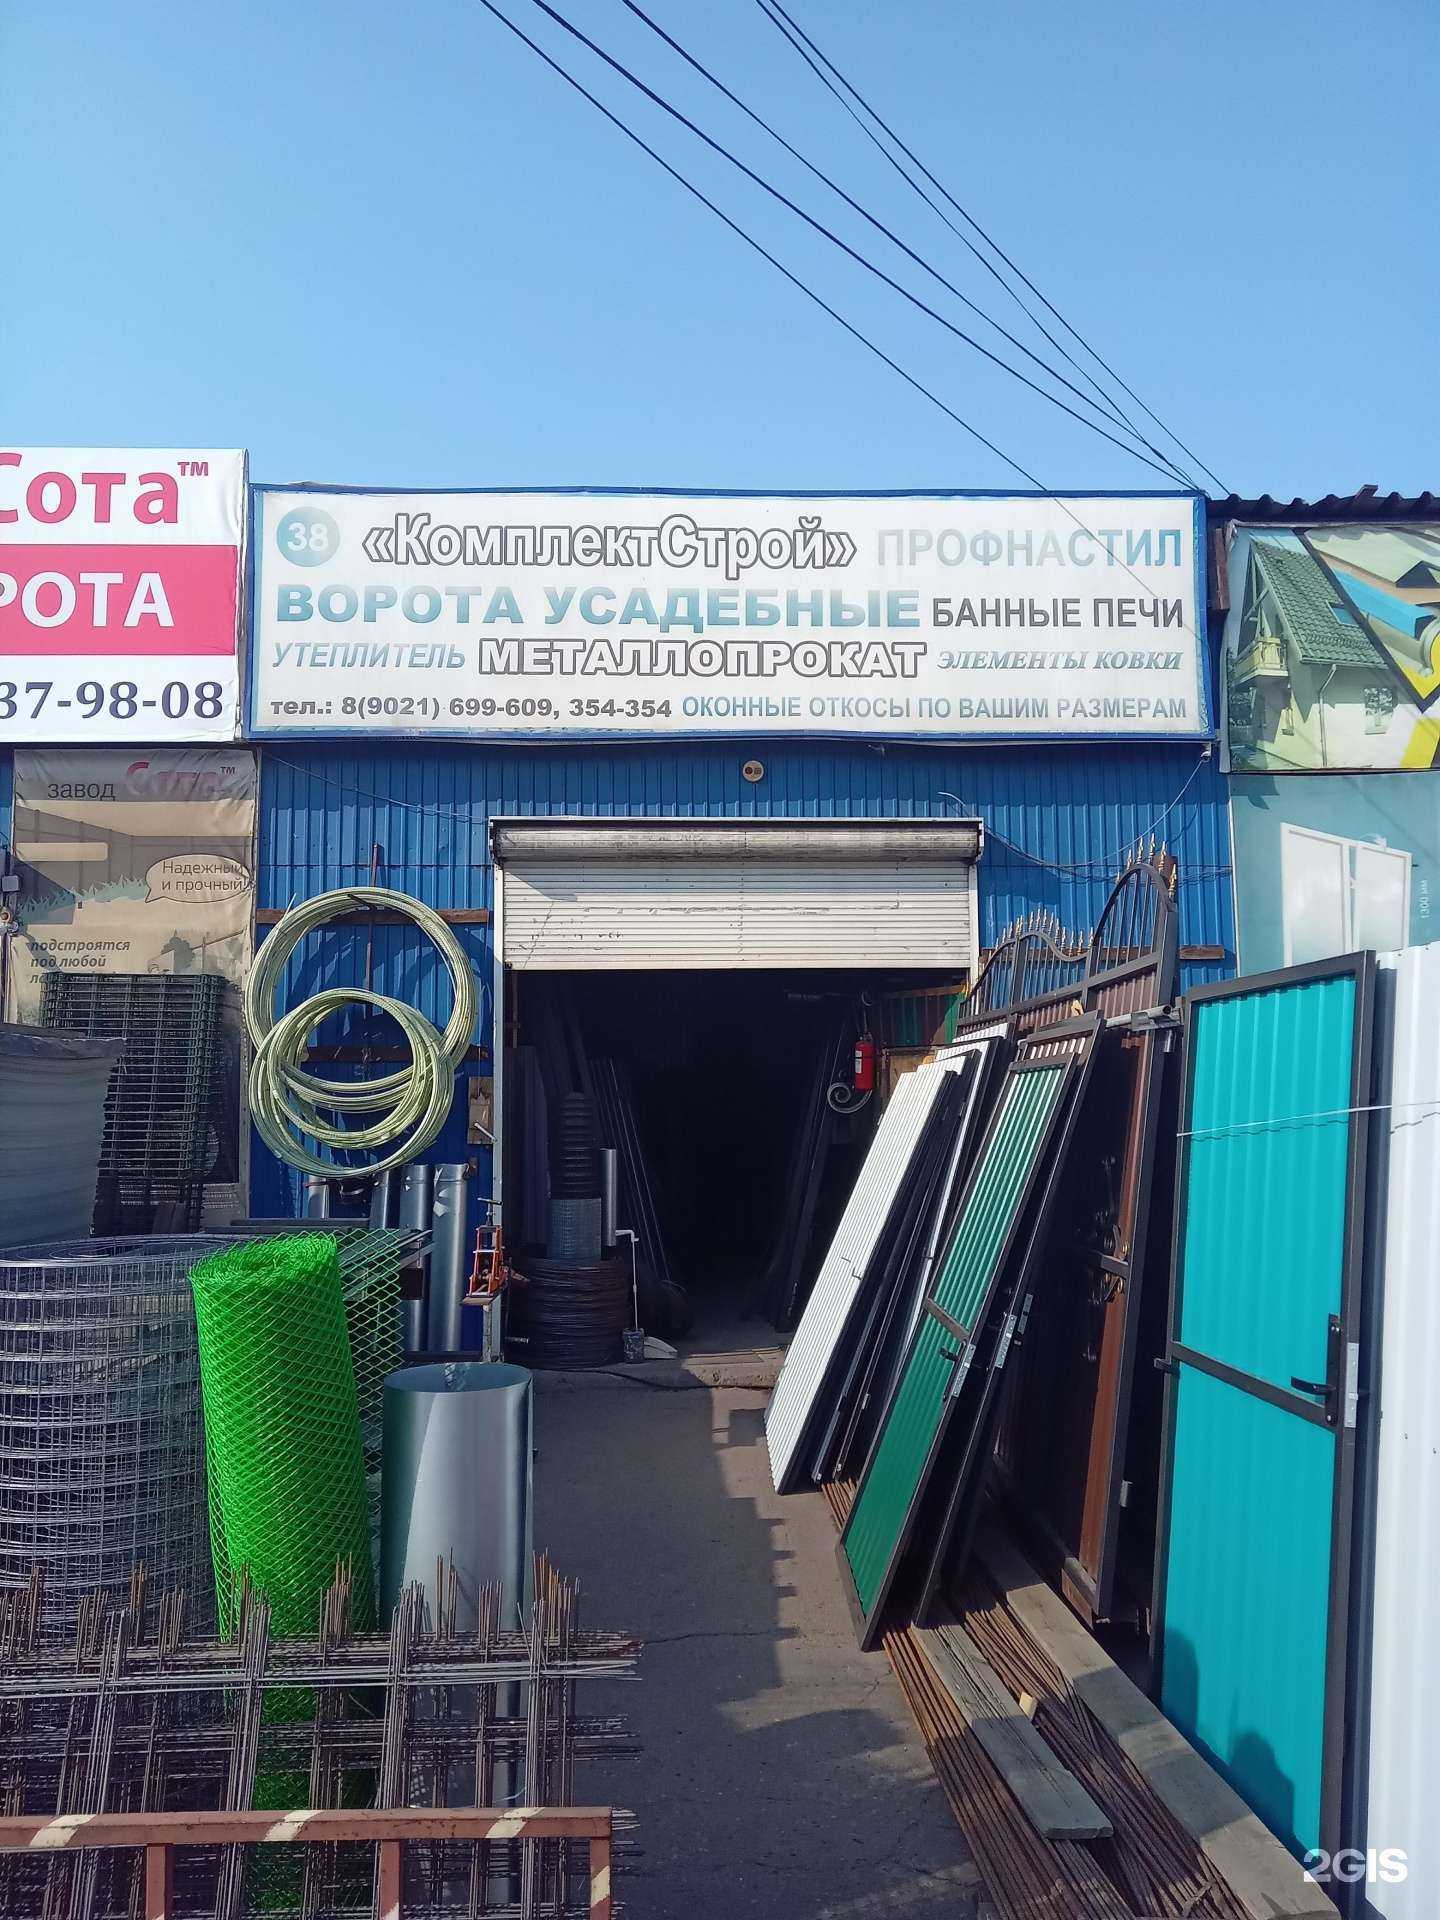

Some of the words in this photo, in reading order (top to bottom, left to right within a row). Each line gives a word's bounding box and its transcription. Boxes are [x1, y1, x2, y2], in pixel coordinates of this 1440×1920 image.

[287, 523, 329, 552] 38
[361, 513, 857, 580] «КомплектСтрой»
[877, 529, 1182, 567] ПРОФНАСТИЛ
[276, 584, 524, 624] ВОРОТА
[545, 586, 920, 633] УСАДЕБНЫЕ
[932, 597, 1081, 628] БАННЫЕ
[1092, 598, 1184, 628] ПЕЧИ
[271, 641, 466, 669] УТЕПЛИТЕЛЬ
[478, 638, 928, 678] МЕТАЛЛОПРОКАТ
[936, 650, 1086, 671] ЭЛЕМЕНТЫ
[1091, 650, 1184, 671] КОВКИ
[341, 695, 440, 718] 8(9021)
[449, 697, 559, 720] 699-609,
[569, 698, 672, 718] 354-354
[682, 696, 801, 717] ОКОННЫЕ
[808, 697, 911, 718] ОТКОСЫ
[918, 697, 951, 718] ПО
[958, 697, 1049, 719] ВАШИМ
[1057, 697, 1187, 719] РАЗМЕРАМ
[47, 783, 116, 800] завод
[162, 860, 243, 876] Надежный
[162, 881, 171, 891] и
[175, 877, 242, 893] прочный
[30, 938, 131, 953] подстроятся
[30, 954, 57, 968] под
[59, 954, 107, 968] любой
